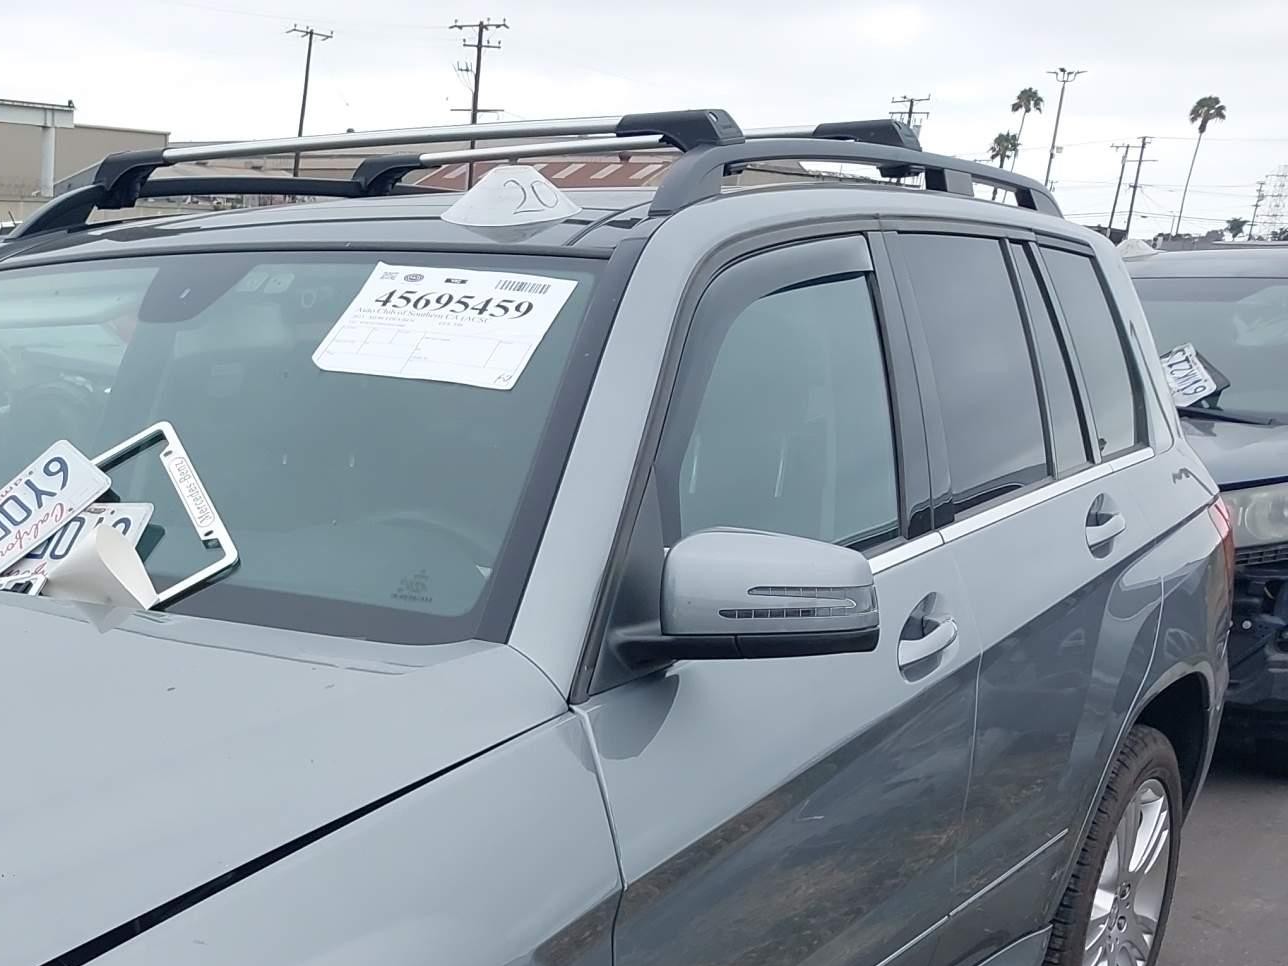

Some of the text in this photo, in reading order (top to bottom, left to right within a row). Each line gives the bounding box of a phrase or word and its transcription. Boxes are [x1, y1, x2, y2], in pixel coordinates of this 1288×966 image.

[503, 178, 559, 215] 20
[375, 288, 534, 319] 45695459
[174, 460, 212, 524] Mercedes-Benz
